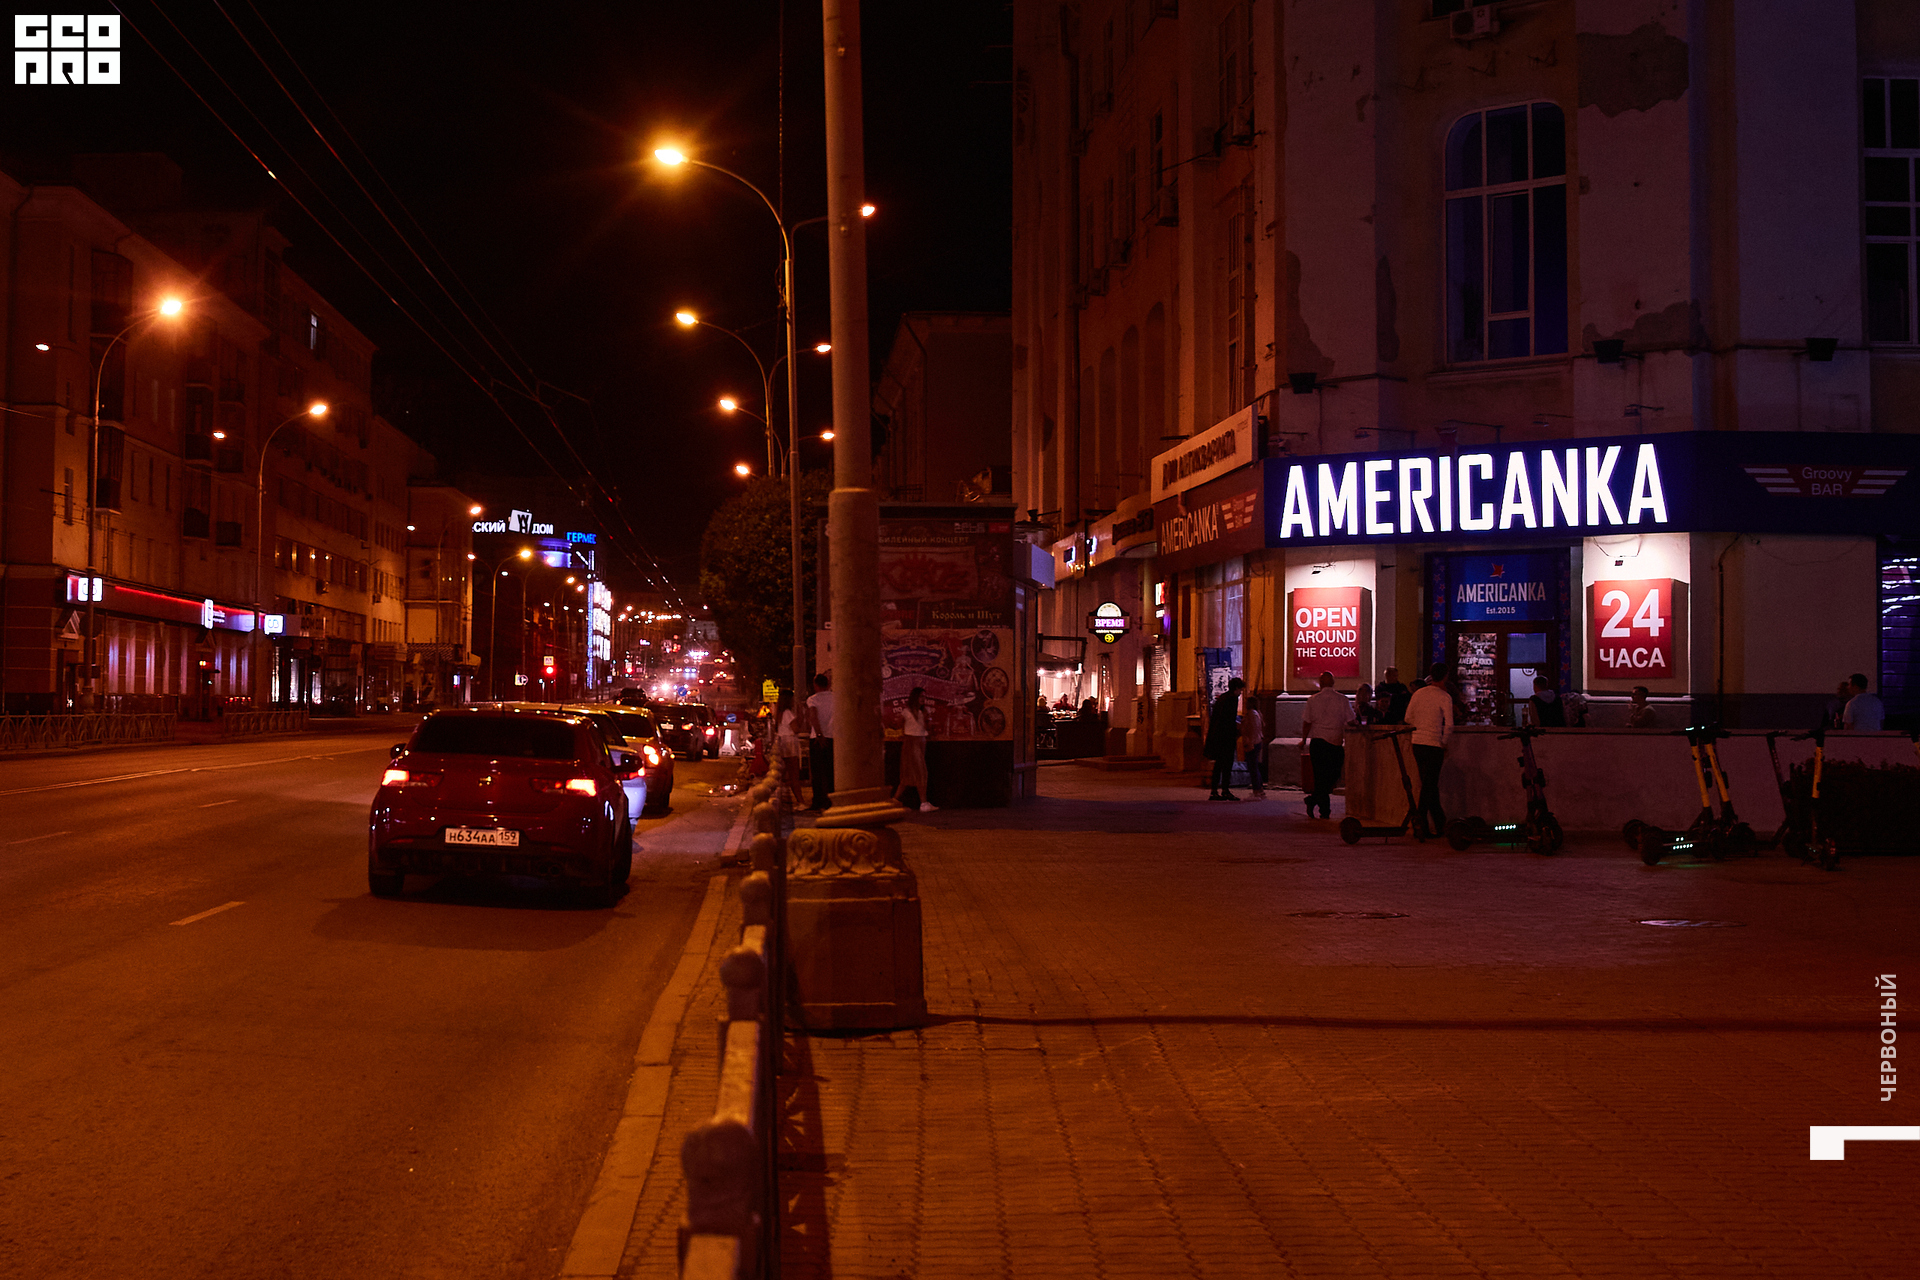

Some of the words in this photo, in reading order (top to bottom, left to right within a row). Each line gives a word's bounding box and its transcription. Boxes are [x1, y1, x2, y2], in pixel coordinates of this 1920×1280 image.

[1802, 466, 1852, 482] Groovy
[1280, 443, 1668, 538] AMERICANKA
[1811, 483, 1843, 495] BAR
[472, 519, 506, 533] СКИЙ
[531, 523, 554, 535] ДОМ
[1161, 503, 1219, 556] AMERICANKA
[566, 532, 597, 545] ГЕРМЕС
[930, 535, 969, 544] КОНЦЕРТ
[1457, 582, 1546, 603] AMERICANKA
[931, 610, 966, 621] Король
[977, 610, 1003, 622] Шут
[1295, 606, 1357, 628] OPEN
[1602, 588, 1665, 638] 24
[1094, 618, 1125, 628] ВРЕМЯ
[1295, 629, 1357, 644] AROUND
[1296, 647, 1317, 658] THE
[1319, 646, 1357, 658] CLOCK
[1600, 647, 1666, 668] ЧАСА
[449, 830, 496, 843] Н634АА
[498, 831, 517, 841] 159
